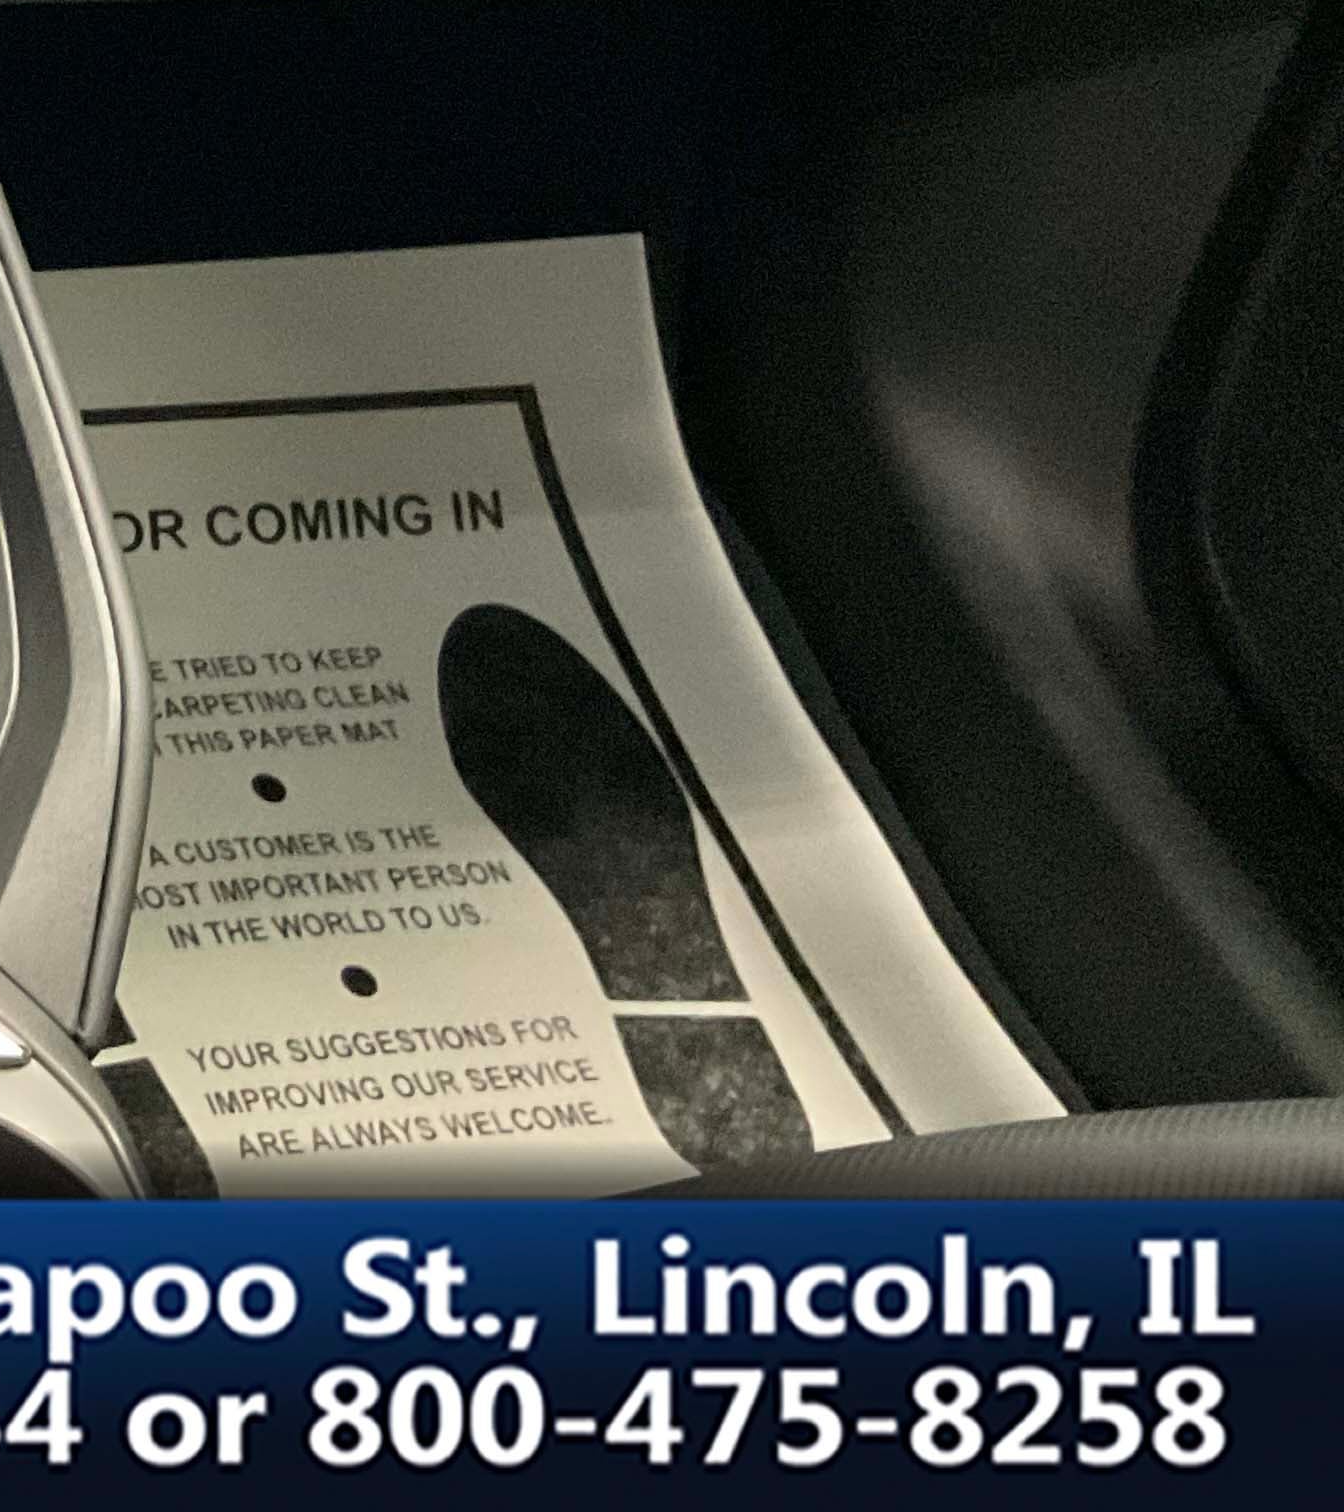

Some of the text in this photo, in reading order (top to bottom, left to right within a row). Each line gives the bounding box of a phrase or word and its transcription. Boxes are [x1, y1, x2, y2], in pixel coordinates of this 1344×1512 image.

[112, 488, 505, 553] OR COMING IN
[174, 654, 256, 682] TRIED
[261, 650, 303, 675] TO
[308, 645, 382, 671] KEEP
[312, 680, 411, 709] CLEAN
[165, 729, 234, 756] THIS
[239, 722, 337, 751] PAPER
[340, 718, 401, 744] MAT
[148, 824, 442, 868] A CUSTOMER IS THE
[208, 868, 380, 904] IMPORTANT
[387, 860, 513, 889] PERSON
[167, 923, 201, 950] IN
[203, 916, 270, 945] THE
[274, 910, 387, 941] WORLD
[389, 905, 432, 931] TO
[186, 1015, 579, 1074] YOUR SUGGESTIONS FOR
[205, 1057, 600, 1116] IMPROVING OUR SERVICE
[238, 1129, 304, 1160] ARE
[311, 1116, 438, 1154] ALWAYS
